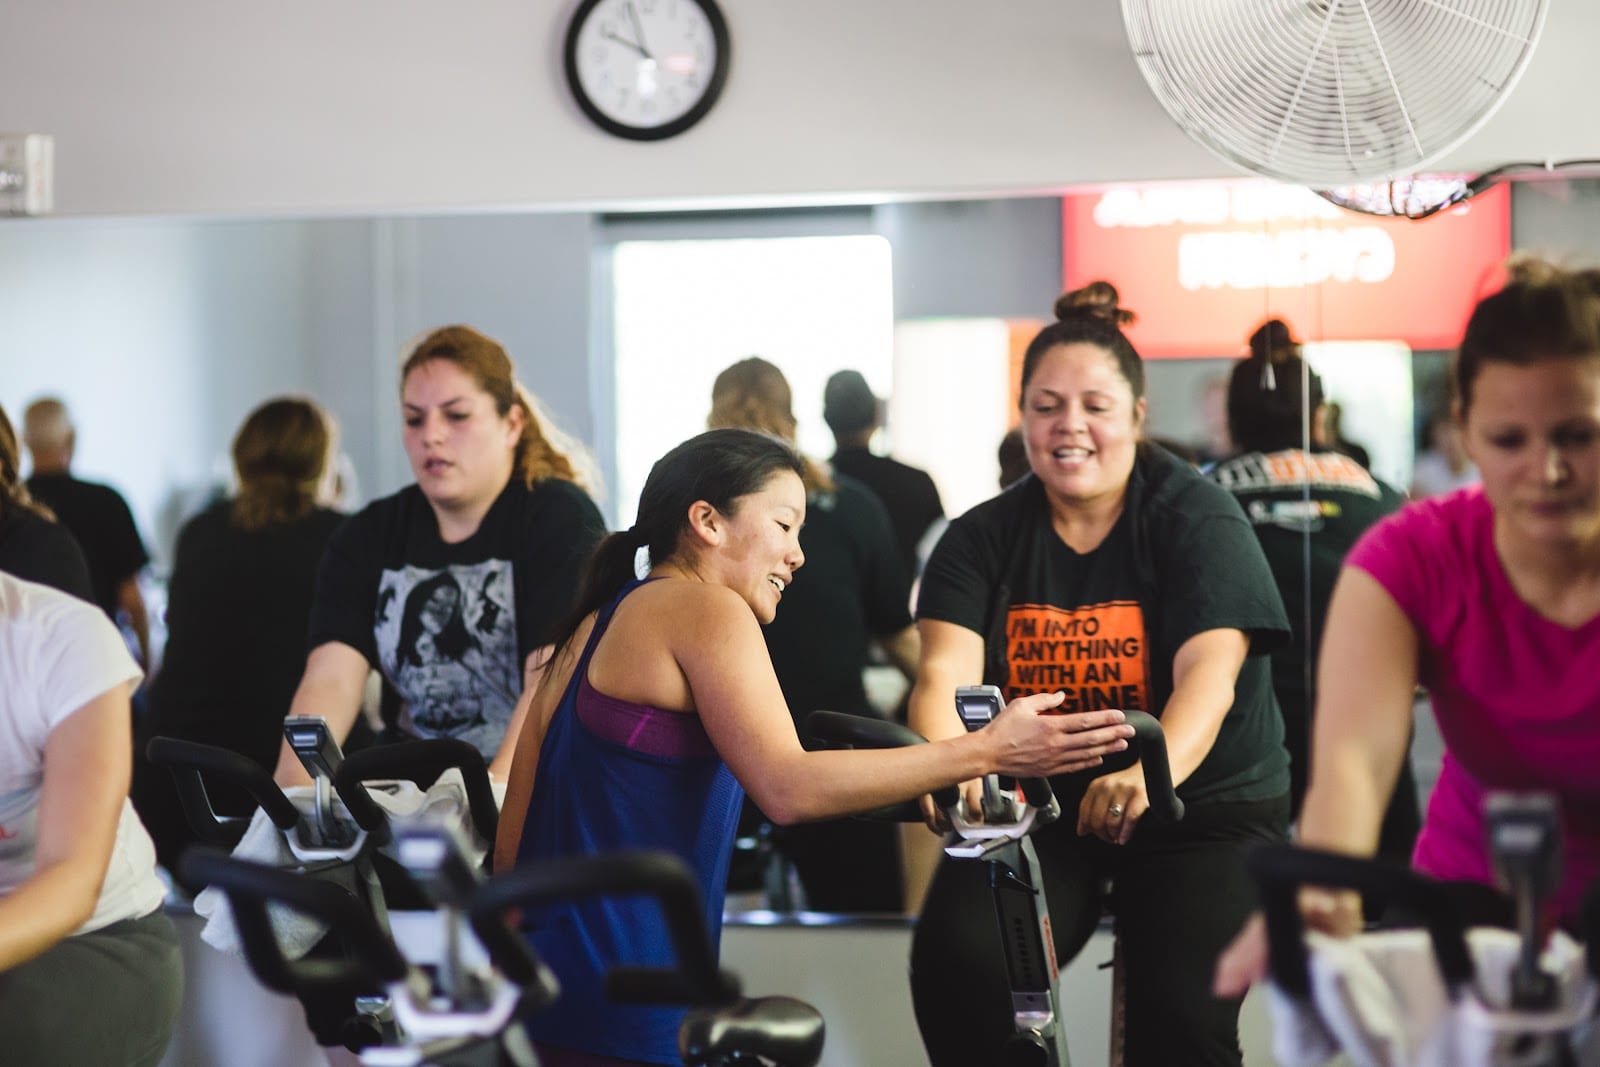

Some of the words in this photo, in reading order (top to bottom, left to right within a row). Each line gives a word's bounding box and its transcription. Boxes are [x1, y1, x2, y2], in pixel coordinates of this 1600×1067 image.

[1011, 618, 1036, 638] I'M
[1043, 617, 1099, 637] INTO
[1012, 638, 1139, 661] ANYTHING
[1016, 664, 1075, 684] WITH
[1083, 662, 1120, 683] AN
[1009, 685, 1139, 713] GINE
